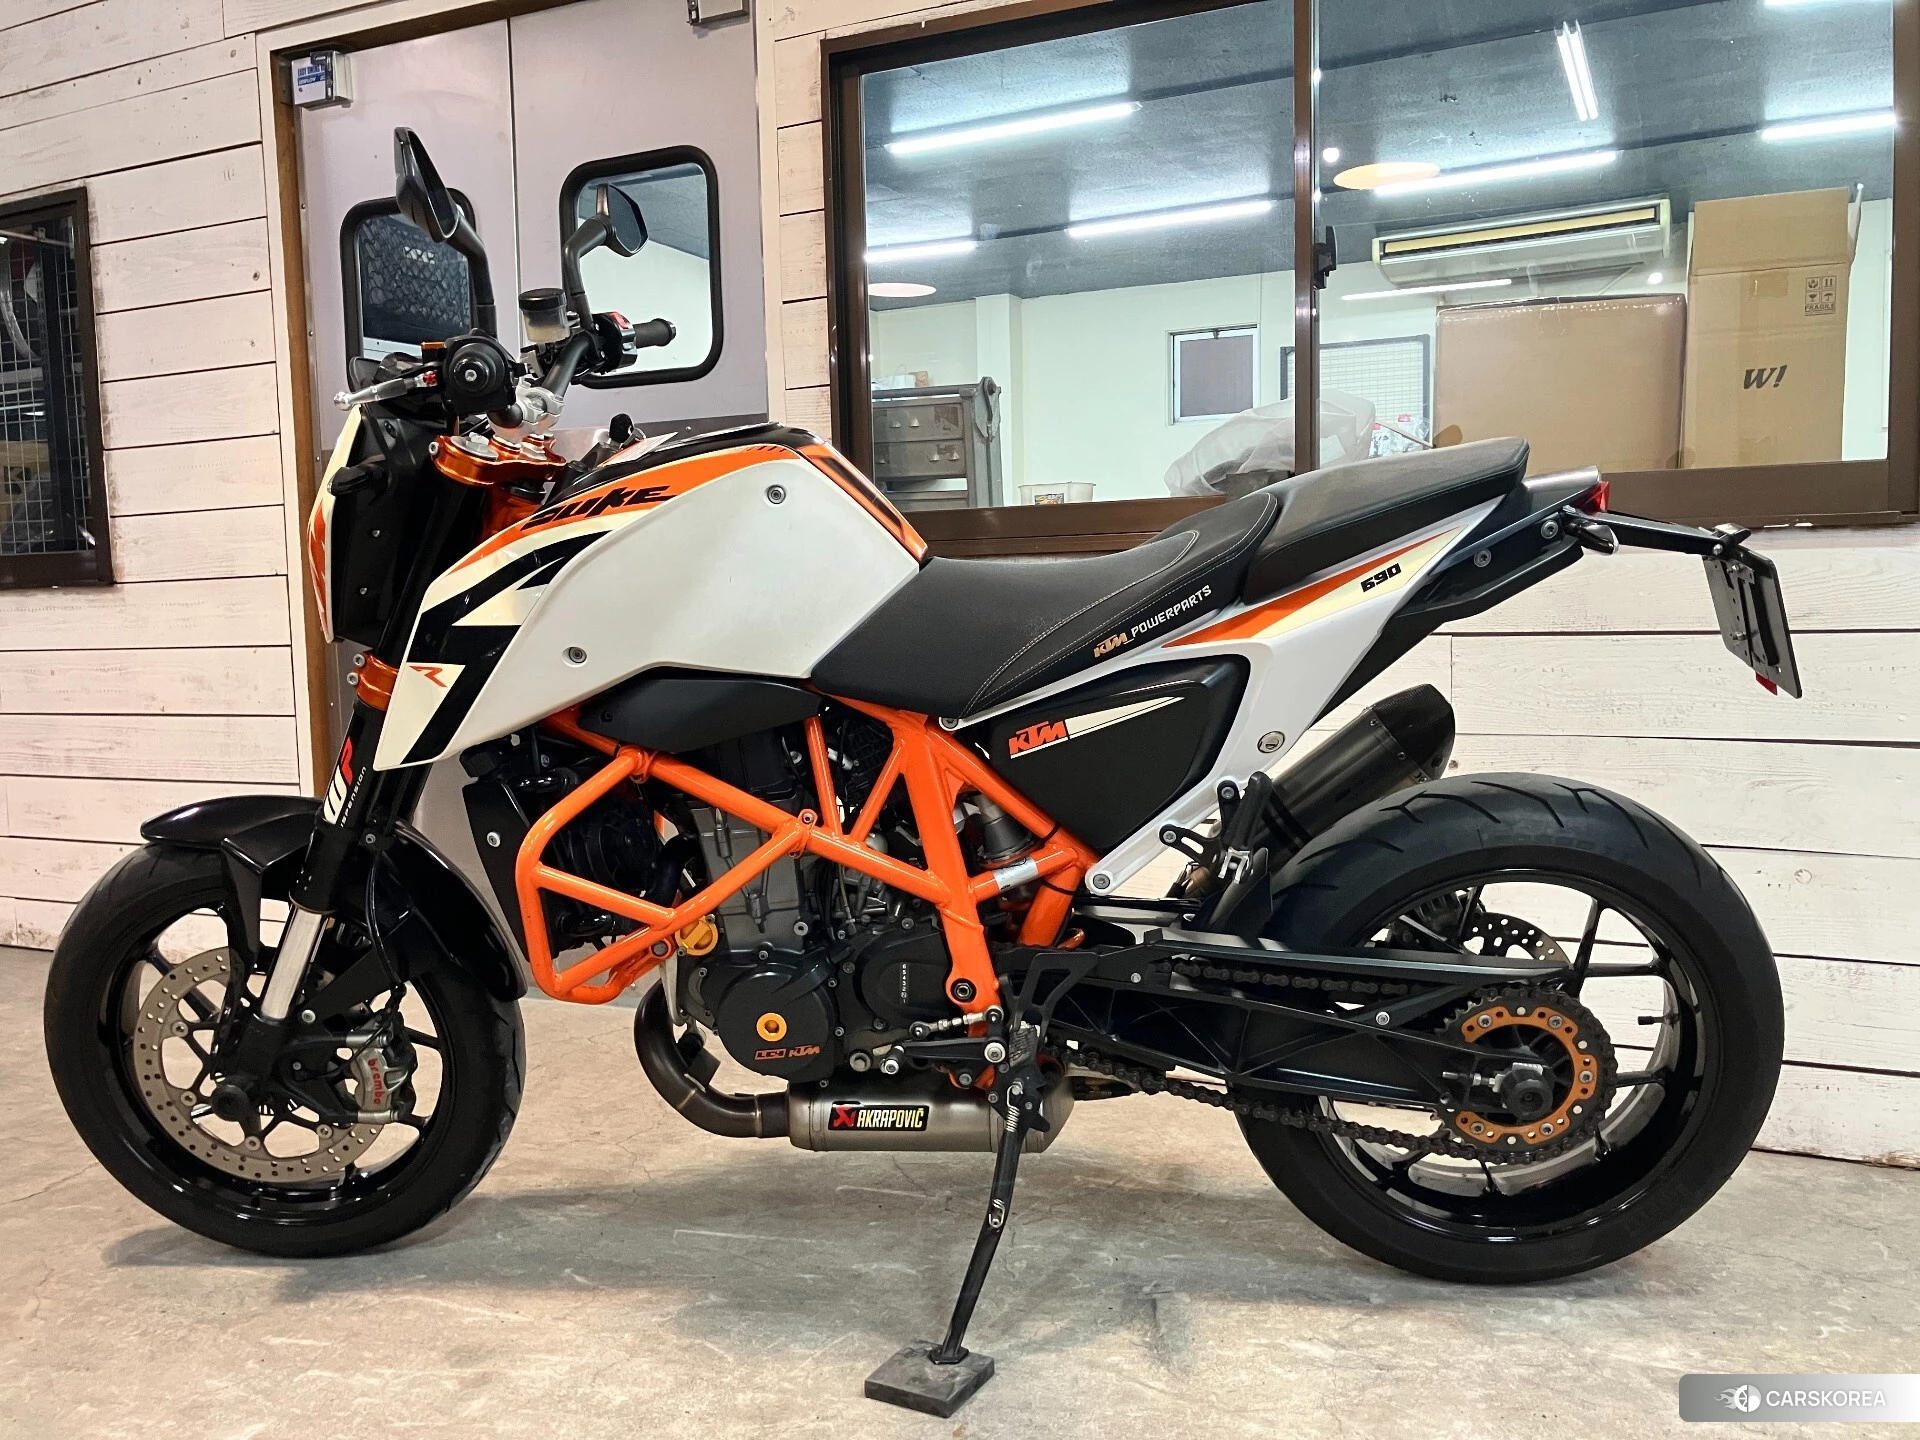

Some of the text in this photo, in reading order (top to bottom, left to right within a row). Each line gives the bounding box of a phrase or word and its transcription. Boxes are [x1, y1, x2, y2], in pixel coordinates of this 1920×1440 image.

[1804, 302, 1836, 312] FRAGILE
[1743, 364, 1788, 390] W!
[1360, 562, 1402, 593] 690
[1008, 720, 1067, 755] KTM
[788, 1045, 821, 1058] KTM
[367, 1058, 386, 1105] brembo
